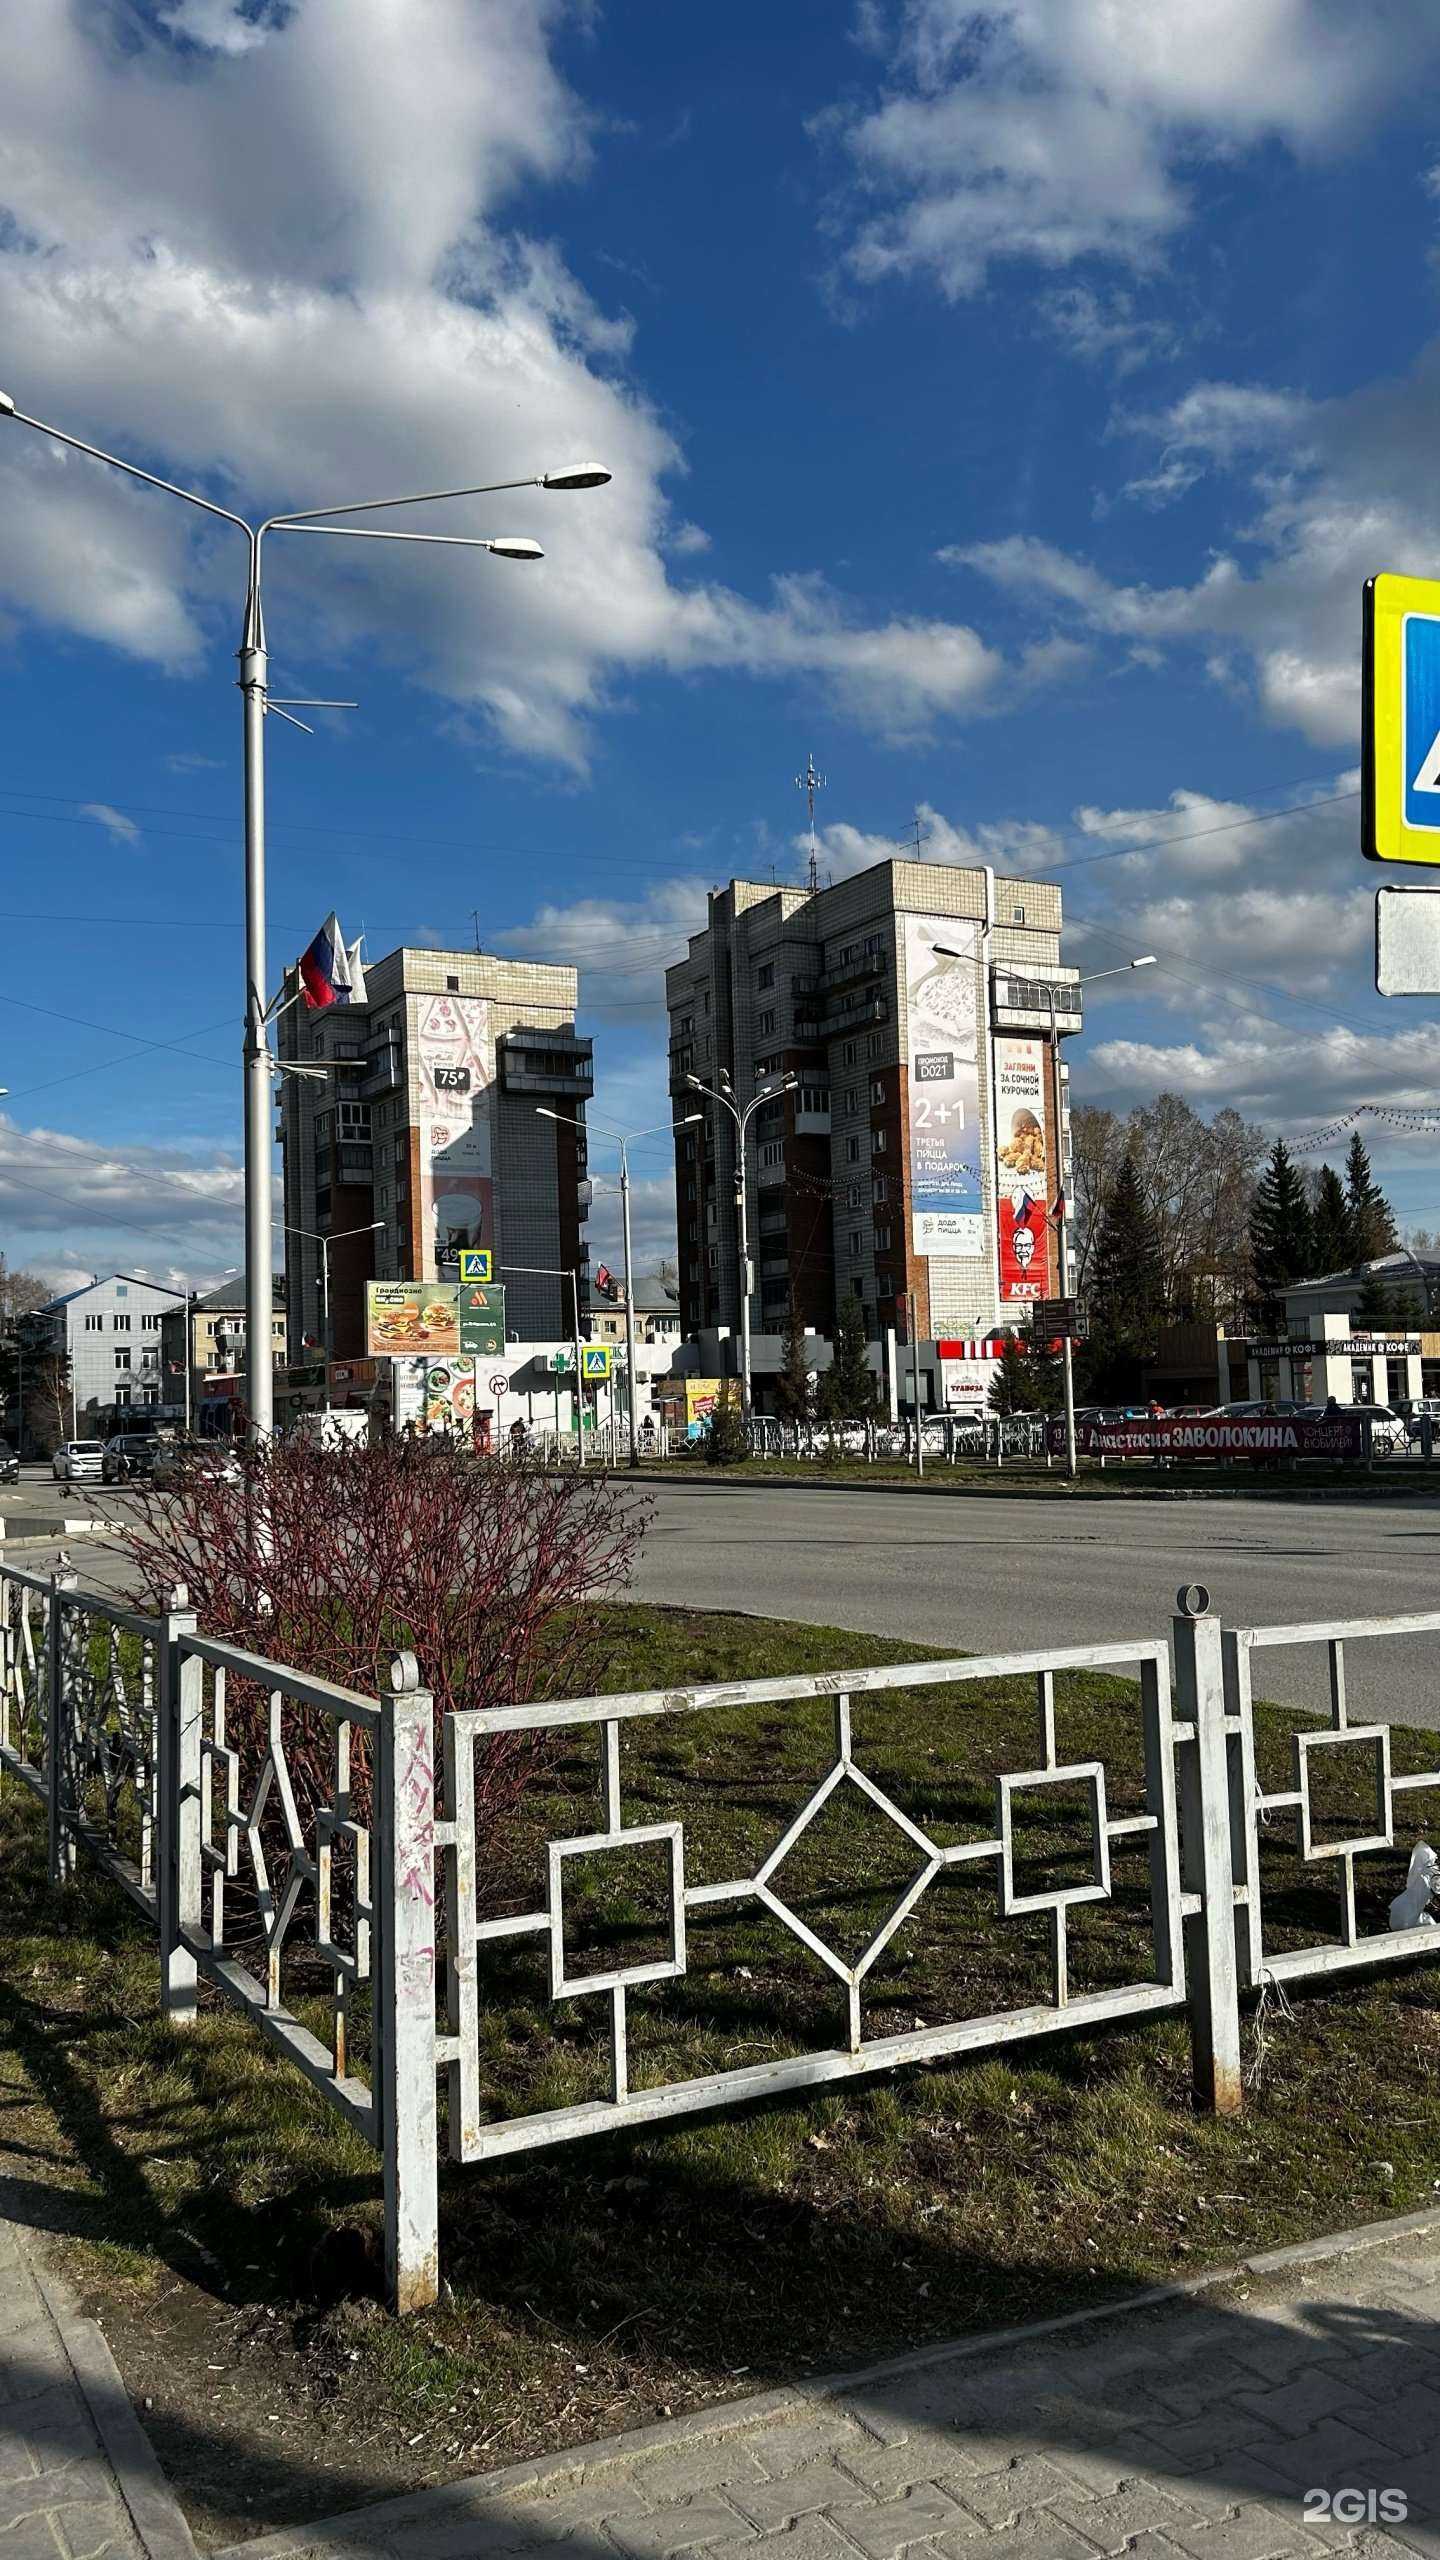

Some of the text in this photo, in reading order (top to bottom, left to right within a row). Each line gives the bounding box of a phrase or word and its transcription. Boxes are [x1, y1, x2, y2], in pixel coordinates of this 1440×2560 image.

[920, 1064, 947, 1078] D021
[1003, 1062, 1036, 1072] ЗАГЛЯНИ
[1000, 1072, 1040, 1085] ЗА СОЧНОЙ
[1001, 1085, 1040, 1097] КУРОЧКОЙ
[915, 1097, 966, 1131] 2+1
[915, 1137, 945, 1148] ТРЕТЬЯ
[916, 1149, 948, 1159] ПИЦЦА
[924, 1162, 967, 1173] ПОДАРОК
[937, 1227, 962, 1235] ПИЦЦА
[1010, 1282, 1042, 1298] KFC
[1292, 1343, 1317, 1354] КОФЕ
[1343, 1342, 1409, 1353] АКАДЕМИЯ КОФЕ
[1089, 1428, 1171, 1448] Анастасия
[1172, 1426, 1299, 1448] ЗАВОЛОКИНА
